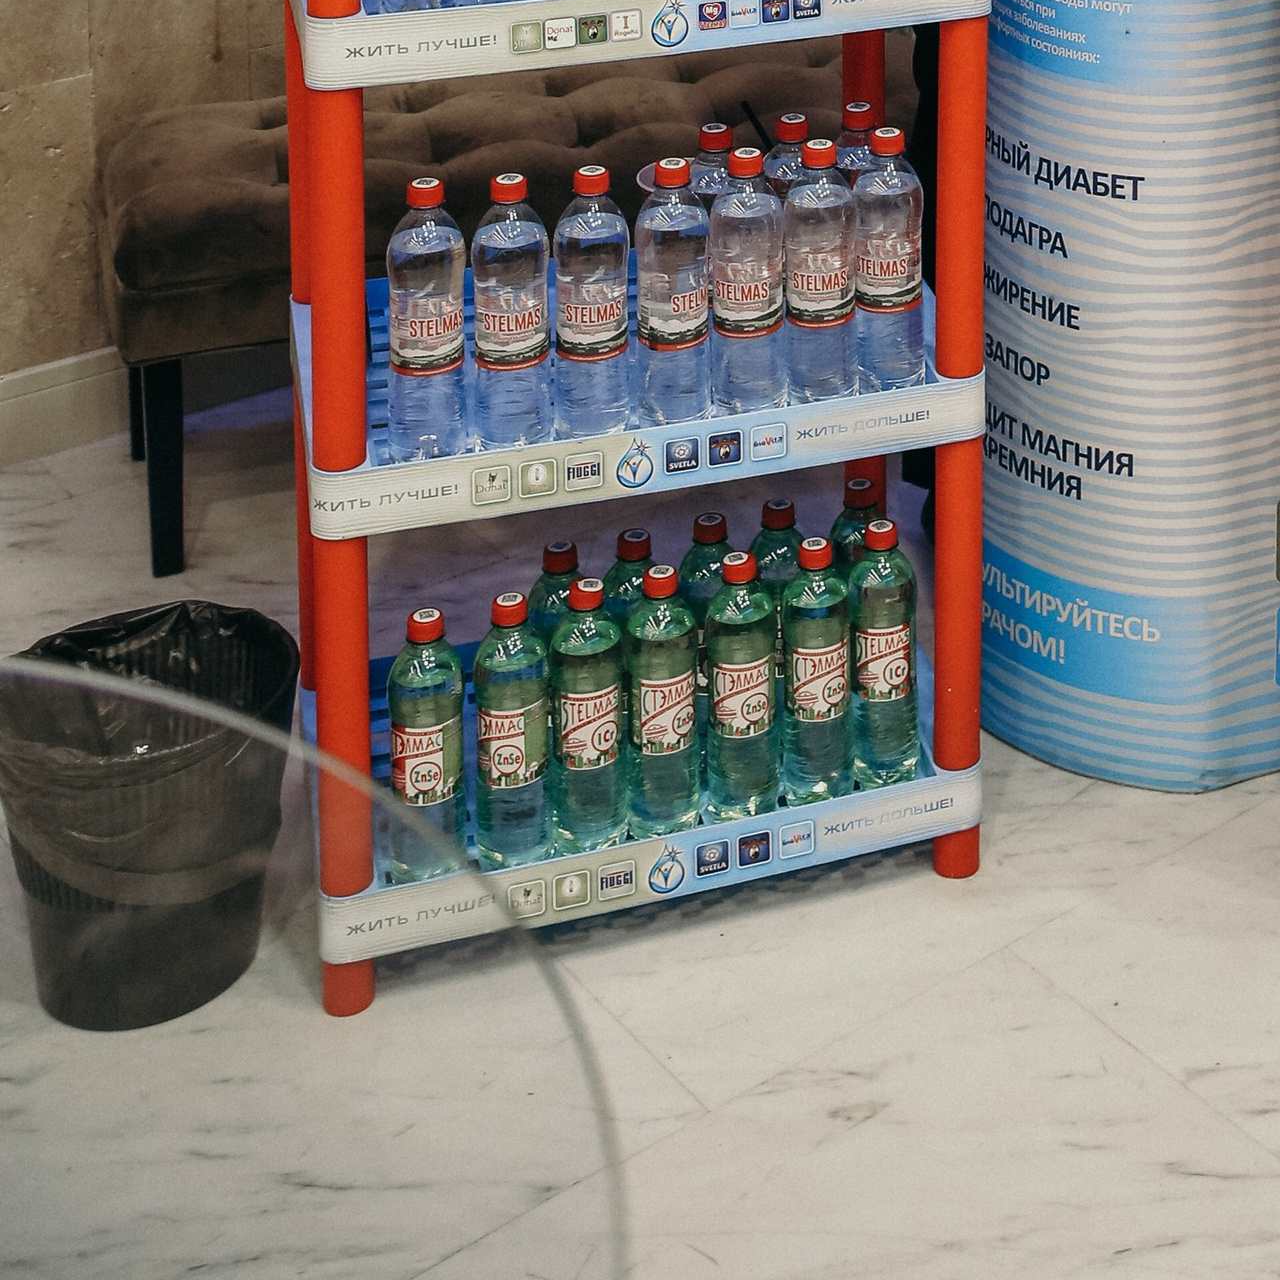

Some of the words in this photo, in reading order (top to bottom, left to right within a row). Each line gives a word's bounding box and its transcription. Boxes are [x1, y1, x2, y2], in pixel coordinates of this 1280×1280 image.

[706, 6, 718, 15] Mg
[796, 8, 819, 17] SVETLA
[1036, 4, 1056, 19] при
[1091, 0, 1133, 17] могут
[547, 26, 573, 35] Donat
[1013, 12, 1087, 44] заболеваниях
[345, 44, 409, 58] ЖИТЬ
[417, 35, 497, 52] ЛУЧШЕ!
[1031, 37, 1101, 64] состояниях:
[1034, 156, 1146, 202] ДИАБЕТ
[856, 256, 906, 277] STELMAS
[716, 280, 767, 302] STELMAS
[793, 271, 846, 292] STELMAS
[409, 309, 463, 338] STELMAS
[484, 309, 538, 333] STELMAS
[566, 302, 621, 324] STELMAS
[986, 332, 1051, 386] ЗАПОР
[797, 424, 848, 441] ЖИТЬ
[852, 410, 930, 433] ДОЛЬШЕ!
[1021, 423, 1134, 478] МАГНИЯ
[567, 463, 600, 481] FIUGGI
[668, 460, 697, 471] SVETLA
[314, 496, 371, 512] ЖИТЬ
[379, 485, 458, 506] ЛУЧШЕ!
[857, 631, 909, 663] STELMAS
[715, 666, 769, 698] СТЭЛМАС
[562, 692, 618, 731] STELMAS
[745, 700, 767, 716] ZnSe
[497, 752, 521, 766] ZnSe
[414, 770, 439, 783] ZnSe
[824, 817, 874, 837] ЖИТЬ
[700, 862, 727, 873] SVETLA
[600, 871, 633, 890] FIUGGI
[346, 915, 409, 936] ЖИТЬ
[416, 894, 495, 922] ЛУЧШЕ!
